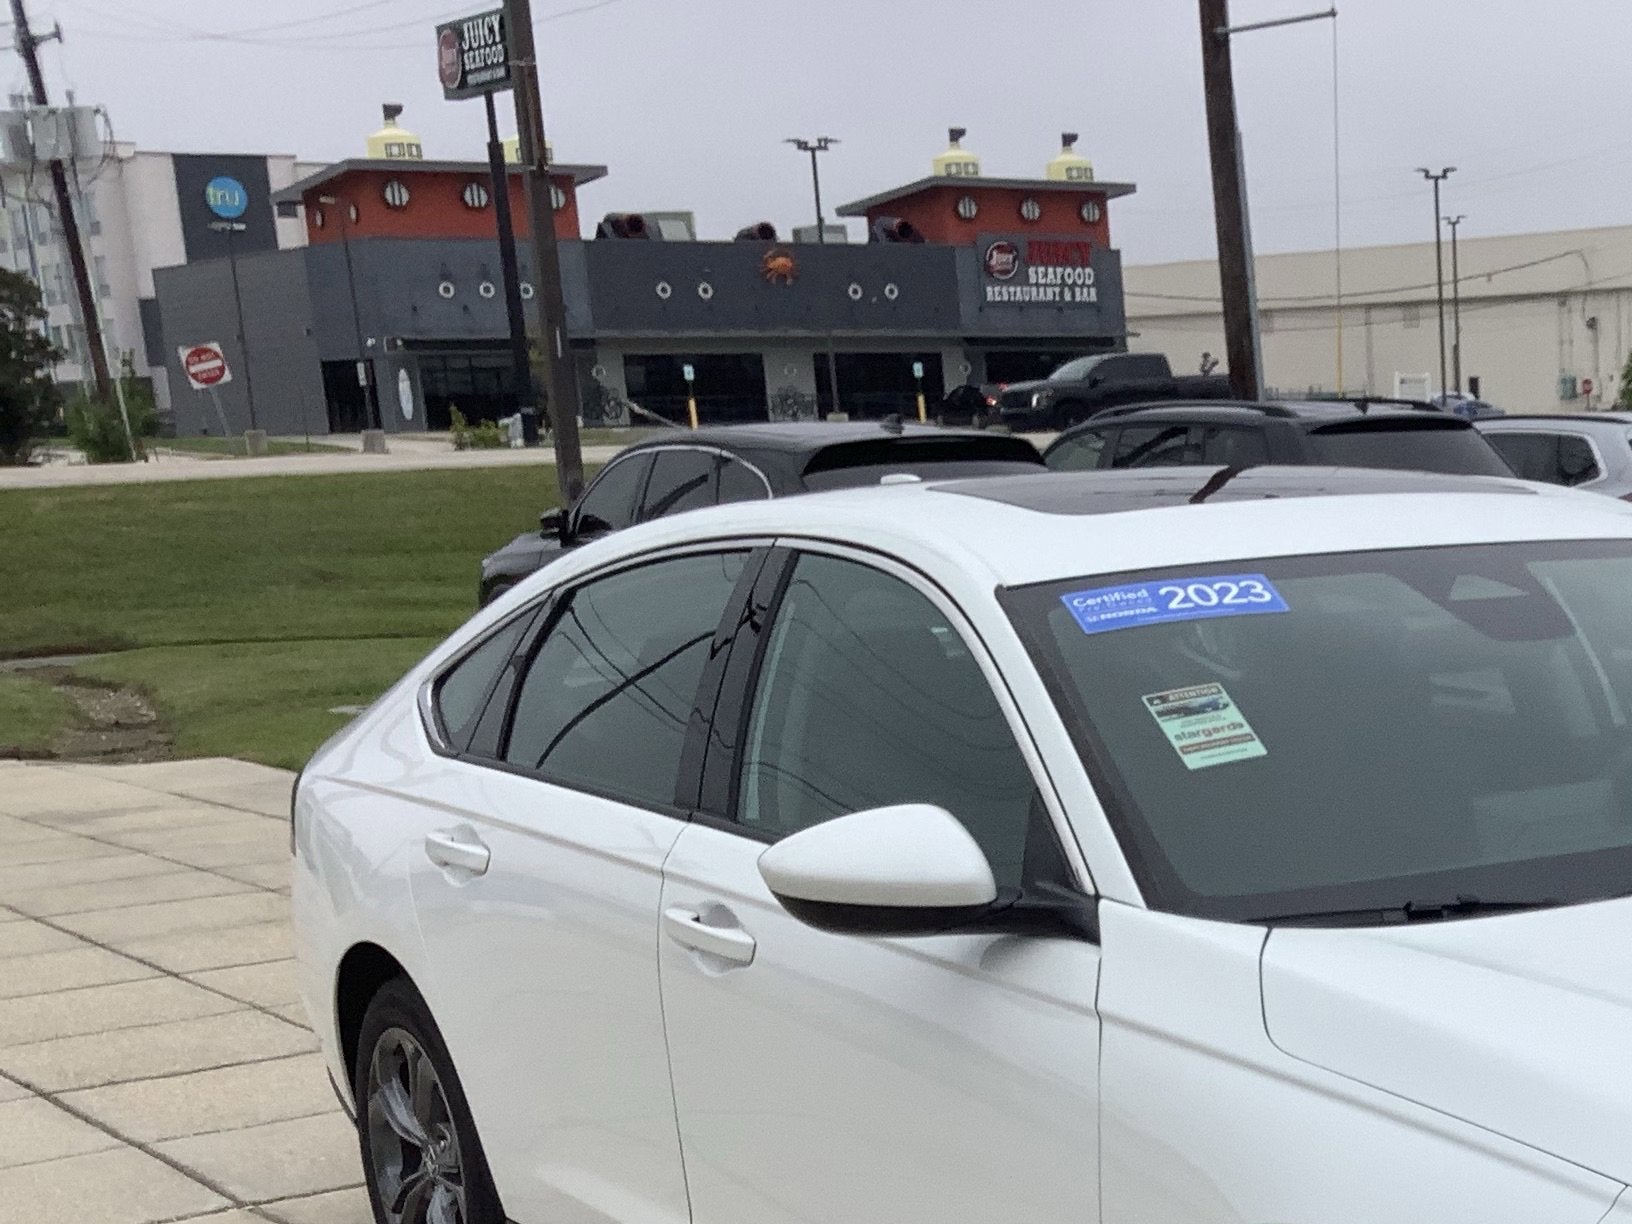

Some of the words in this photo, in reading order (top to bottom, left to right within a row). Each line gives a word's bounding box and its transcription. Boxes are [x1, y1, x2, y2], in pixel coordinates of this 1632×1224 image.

[462, 14, 501, 50] JUICY
[464, 43, 504, 70] SEAFOOD
[1028, 266, 1095, 285] SEAFOOD
[986, 286, 1061, 302] RESTAURANT
[1074, 286, 1098, 302] BAR
[1073, 588, 1148, 607] Certified
[1159, 580, 1272, 610] 2023
